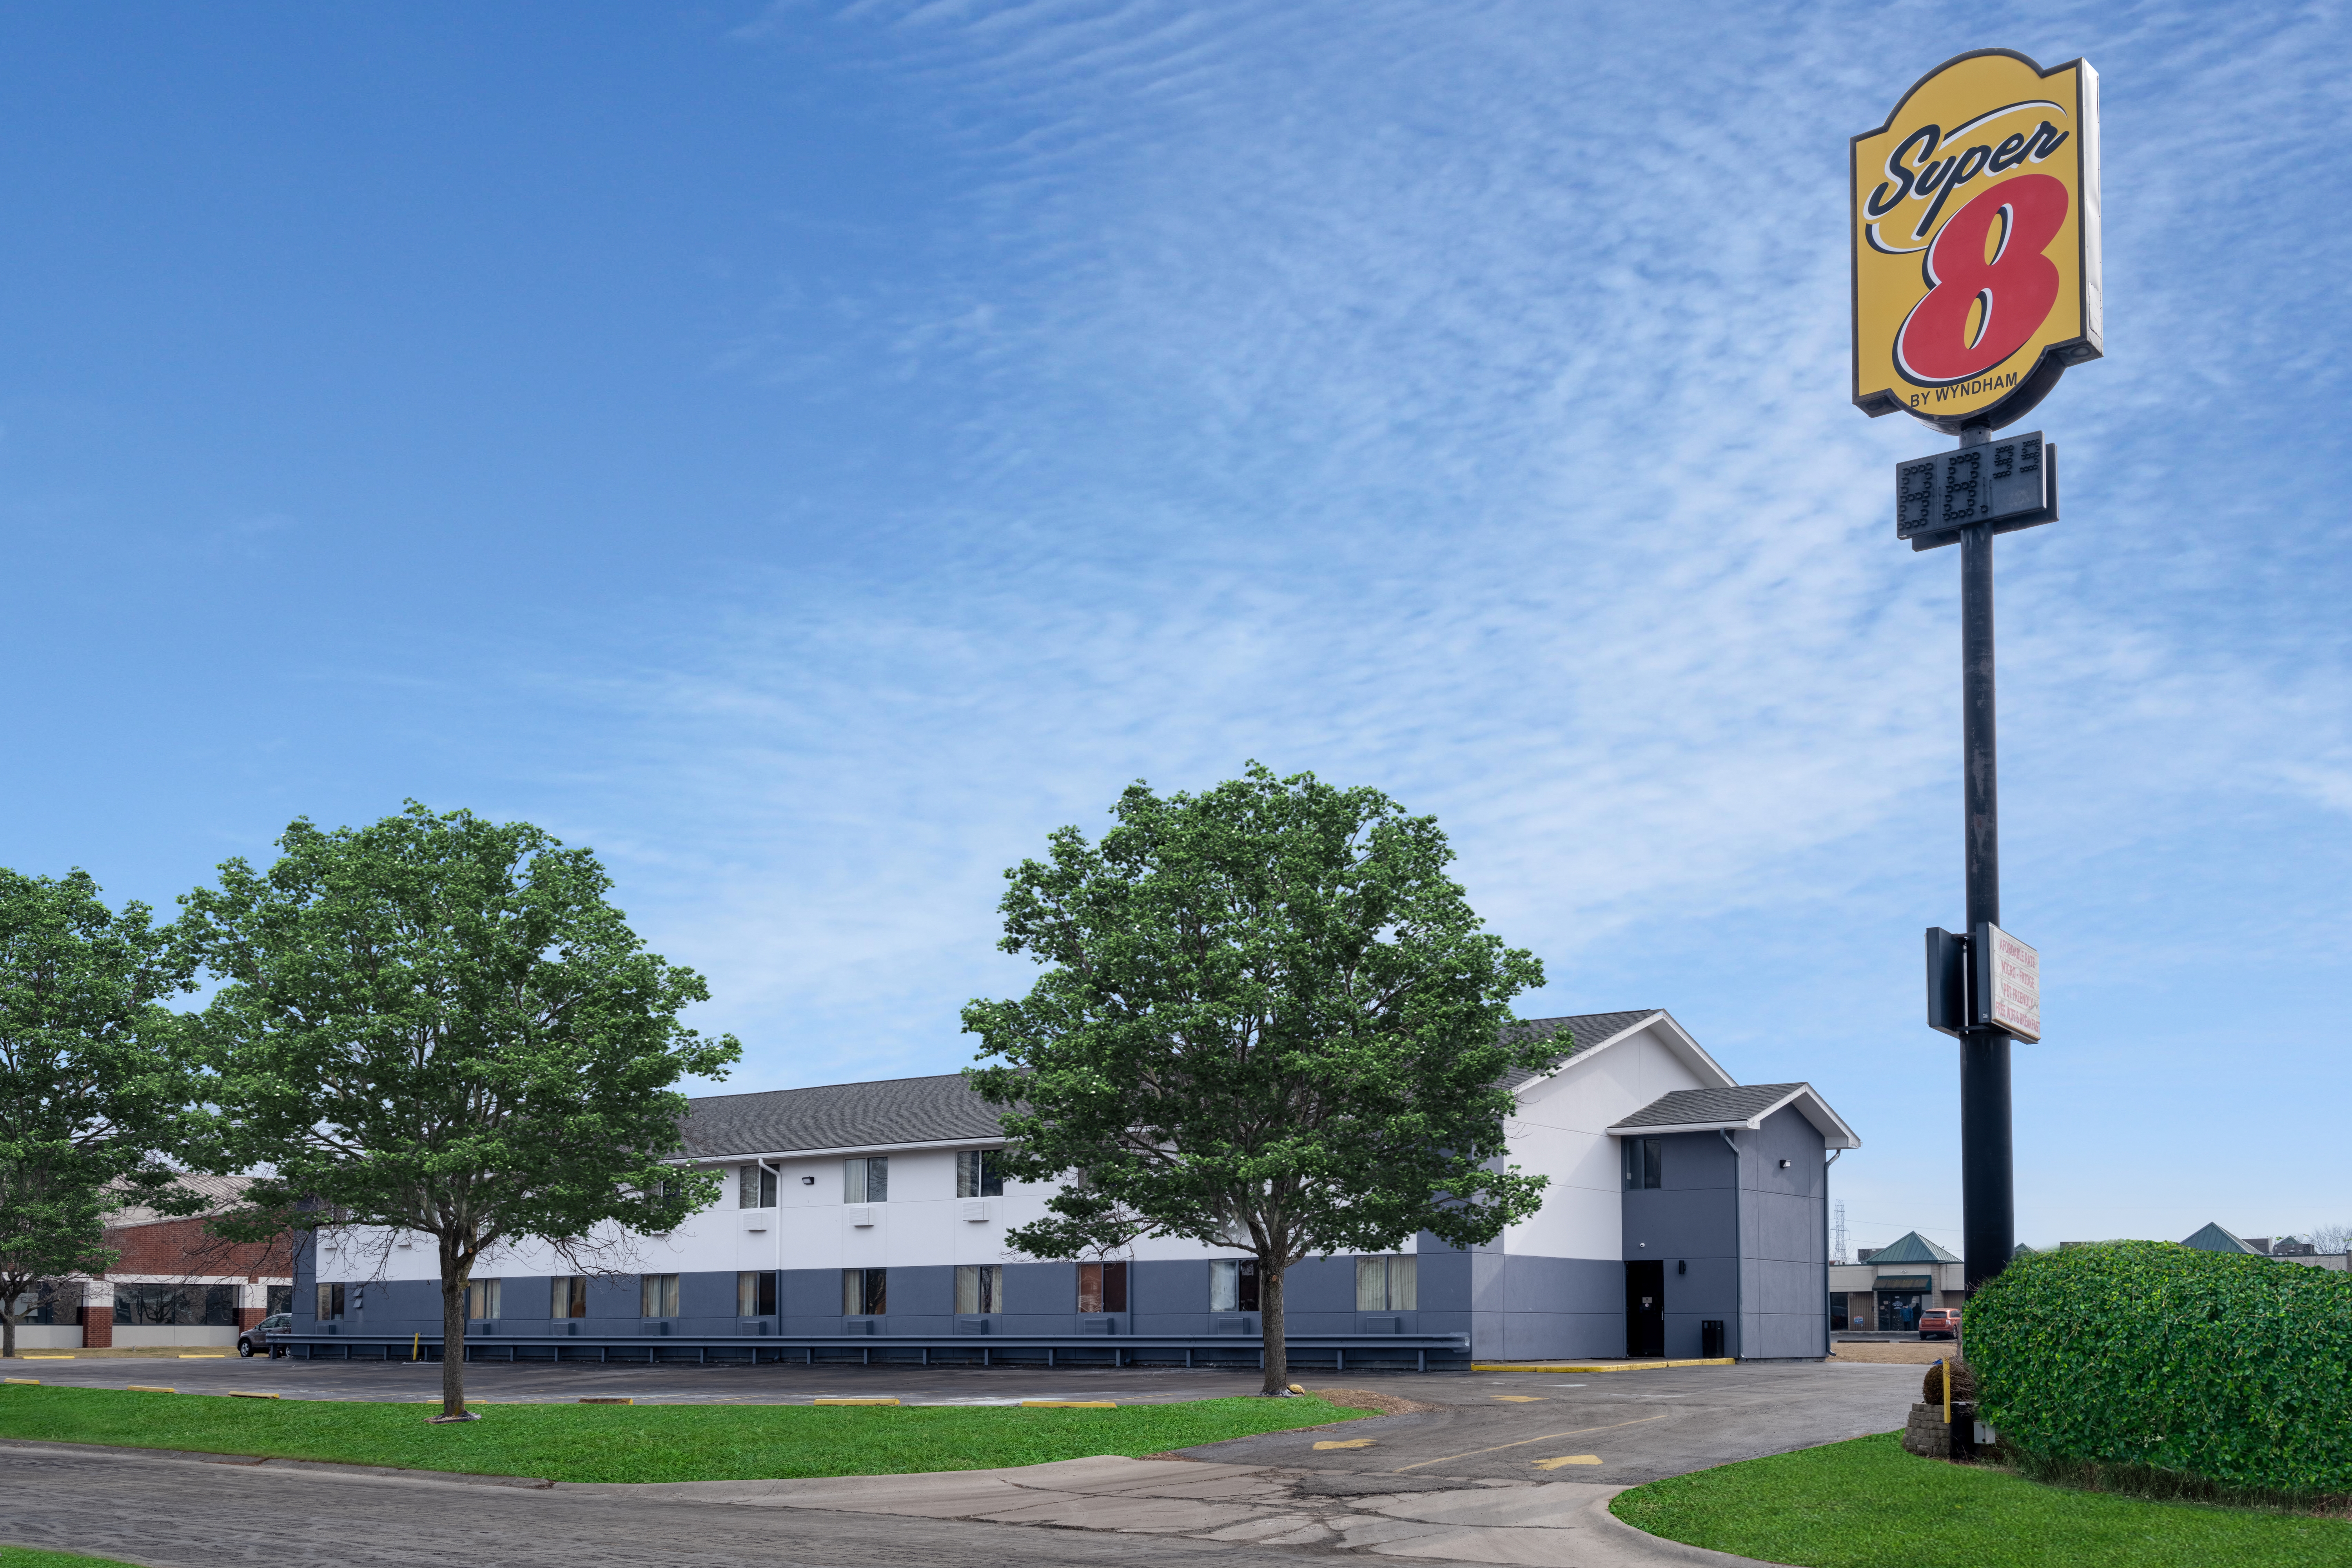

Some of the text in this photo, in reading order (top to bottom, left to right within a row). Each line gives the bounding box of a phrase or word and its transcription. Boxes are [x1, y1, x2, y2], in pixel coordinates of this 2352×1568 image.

[1864, 121, 2069, 240] Super
[1892, 174, 2069, 388] 8
[1910, 372, 2017, 408] BY WYNDHAM
[2000, 938, 2035, 969] AFORDABLE RATE
[2001, 960, 2016, 979] MICRO
[2019, 970, 2034, 989] FRIDGE
[2004, 982, 2033, 1010] PET FRIENDLY
[1996, 1001, 2040, 1034] FREE WIFI & BREAKFAST
